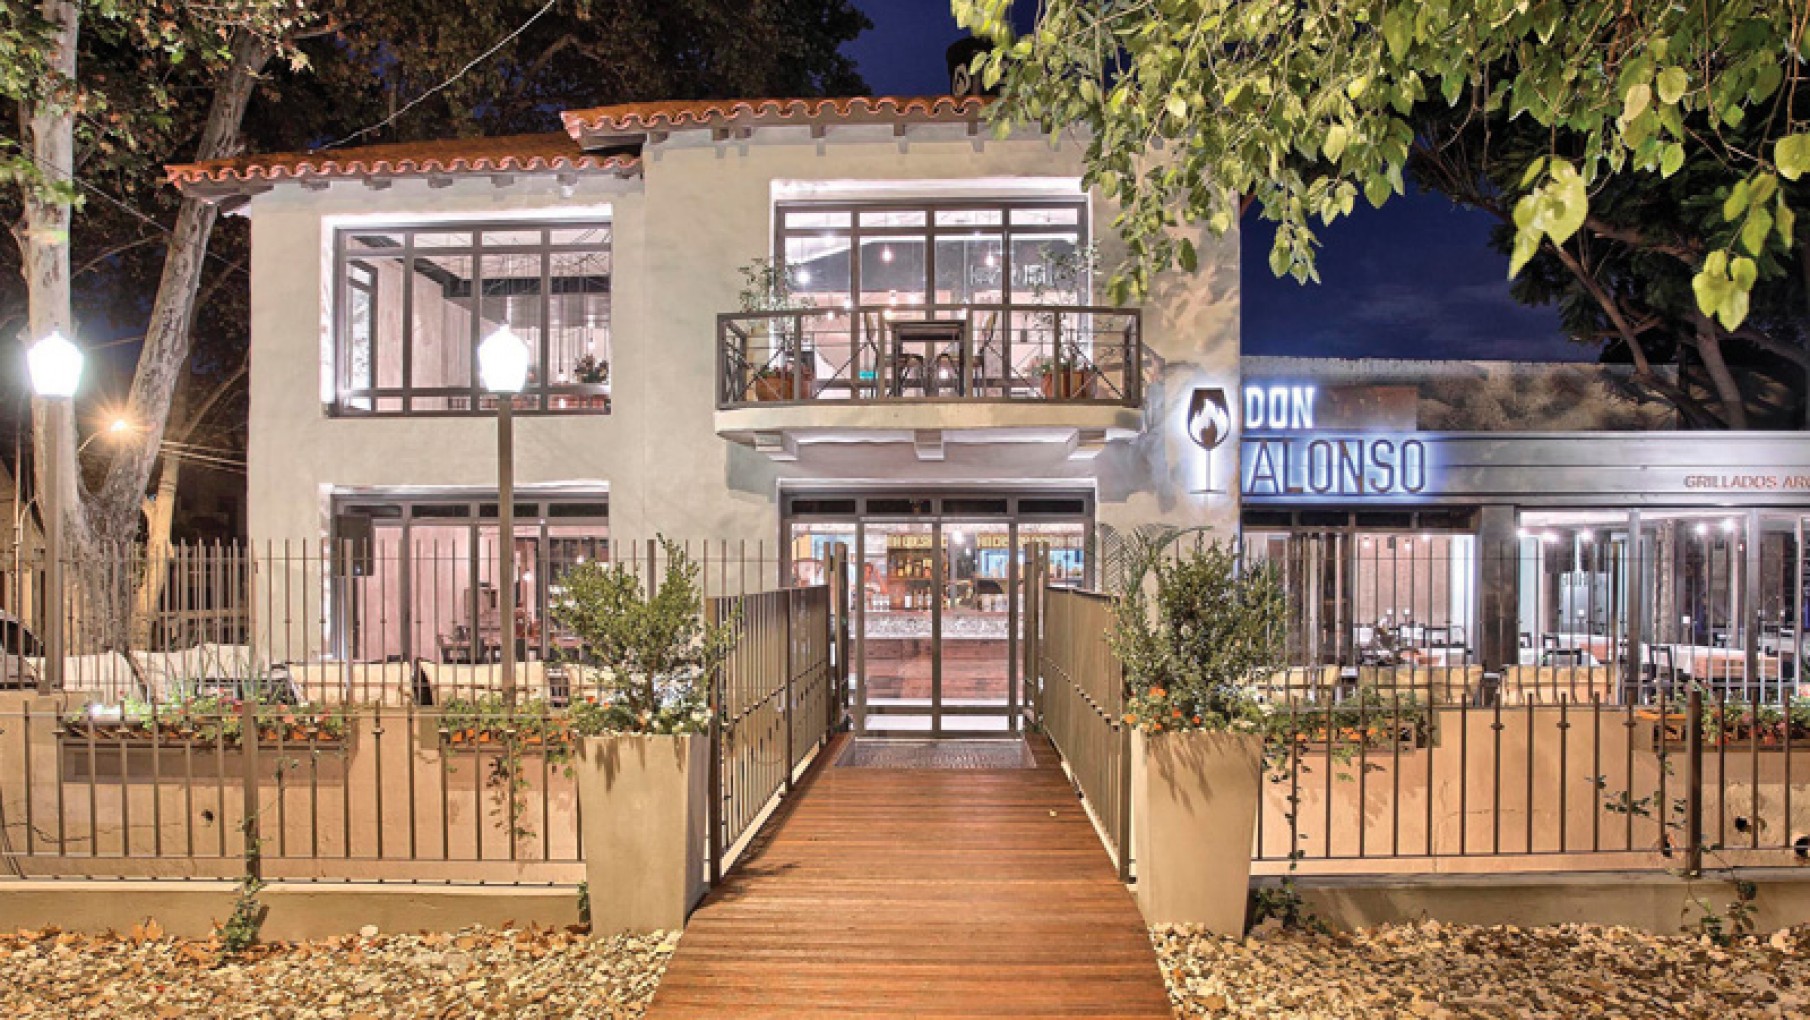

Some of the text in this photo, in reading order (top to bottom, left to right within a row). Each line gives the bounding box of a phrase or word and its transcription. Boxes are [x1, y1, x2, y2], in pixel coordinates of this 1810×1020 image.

[1245, 385, 1315, 429] DON
[1248, 438, 1425, 494] ALONSO
[1683, 475, 1777, 488] GRILLADOS
